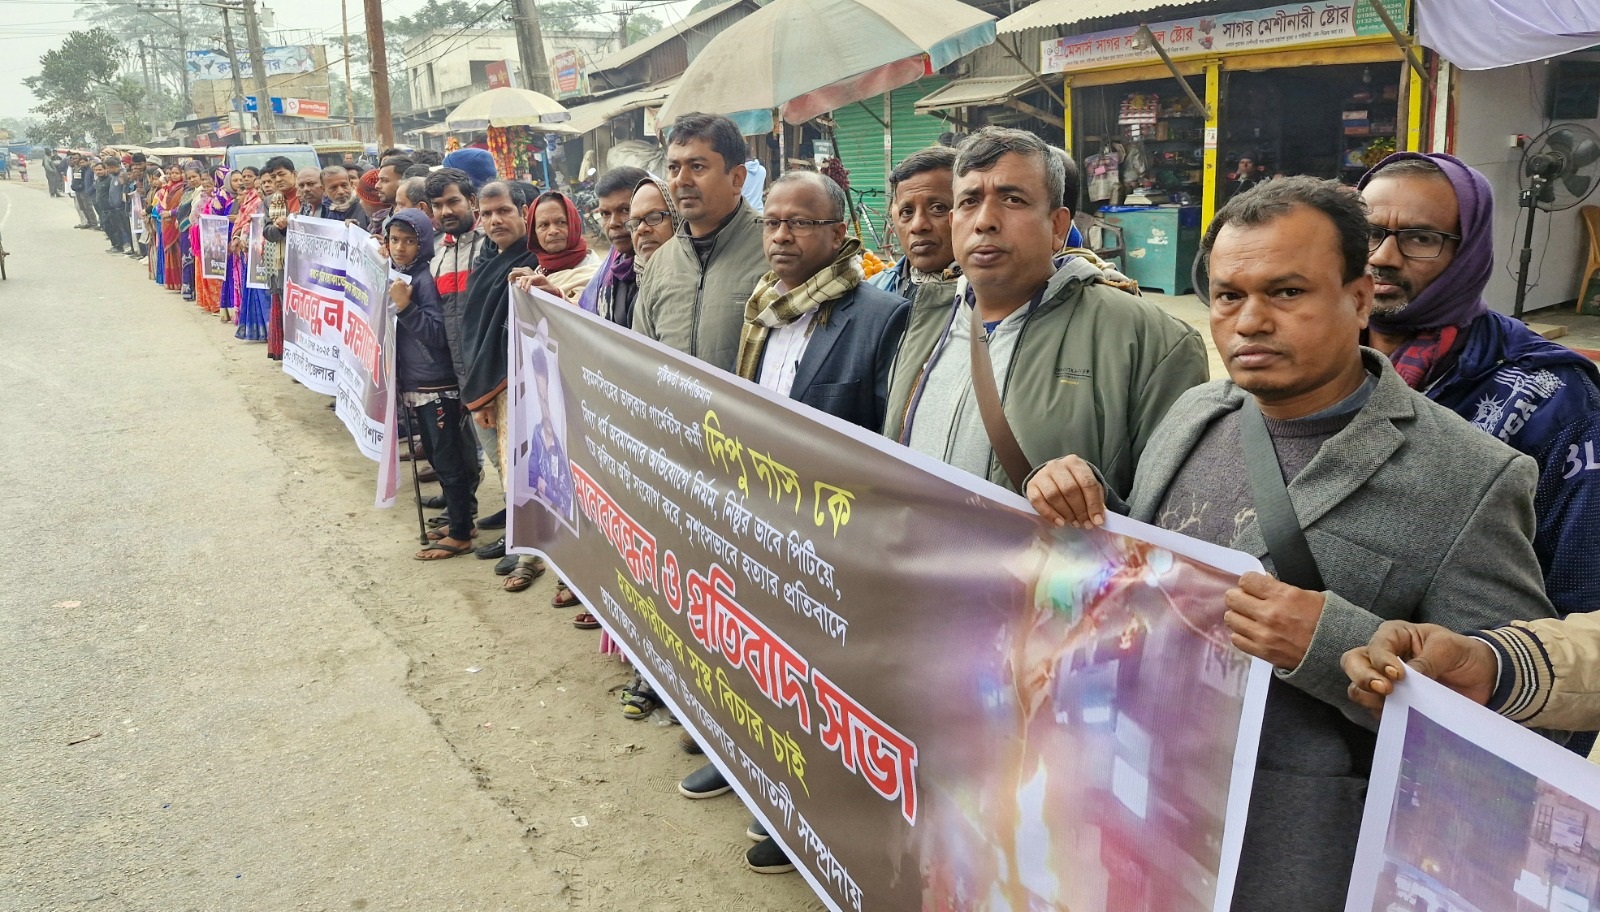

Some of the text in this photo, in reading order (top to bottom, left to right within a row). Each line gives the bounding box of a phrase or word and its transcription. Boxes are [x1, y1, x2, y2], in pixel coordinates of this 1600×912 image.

[1064, 35, 1093, 58] মেসার্স
[1096, 36, 1121, 53] সাগর
[1223, 18, 1253, 39] সাগর
[1320, 3, 1352, 28] ষ্টোর
[648, 447, 692, 494] অভিযোগে
[754, 516, 784, 559] ভাবে
[702, 410, 749, 499] দিপু
[747, 447, 802, 515] দাস
[814, 480, 856, 538] কে
[569, 459, 918, 827] মানববন্ধন ও প্রতিবাদ সভা
[741, 551, 780, 599] হত্যার
[783, 580, 849, 647] প্রতিবাদে
[715, 666, 765, 749] বিচার
[767, 724, 811, 798] চাই
[737, 746, 796, 831] সনাতনী
